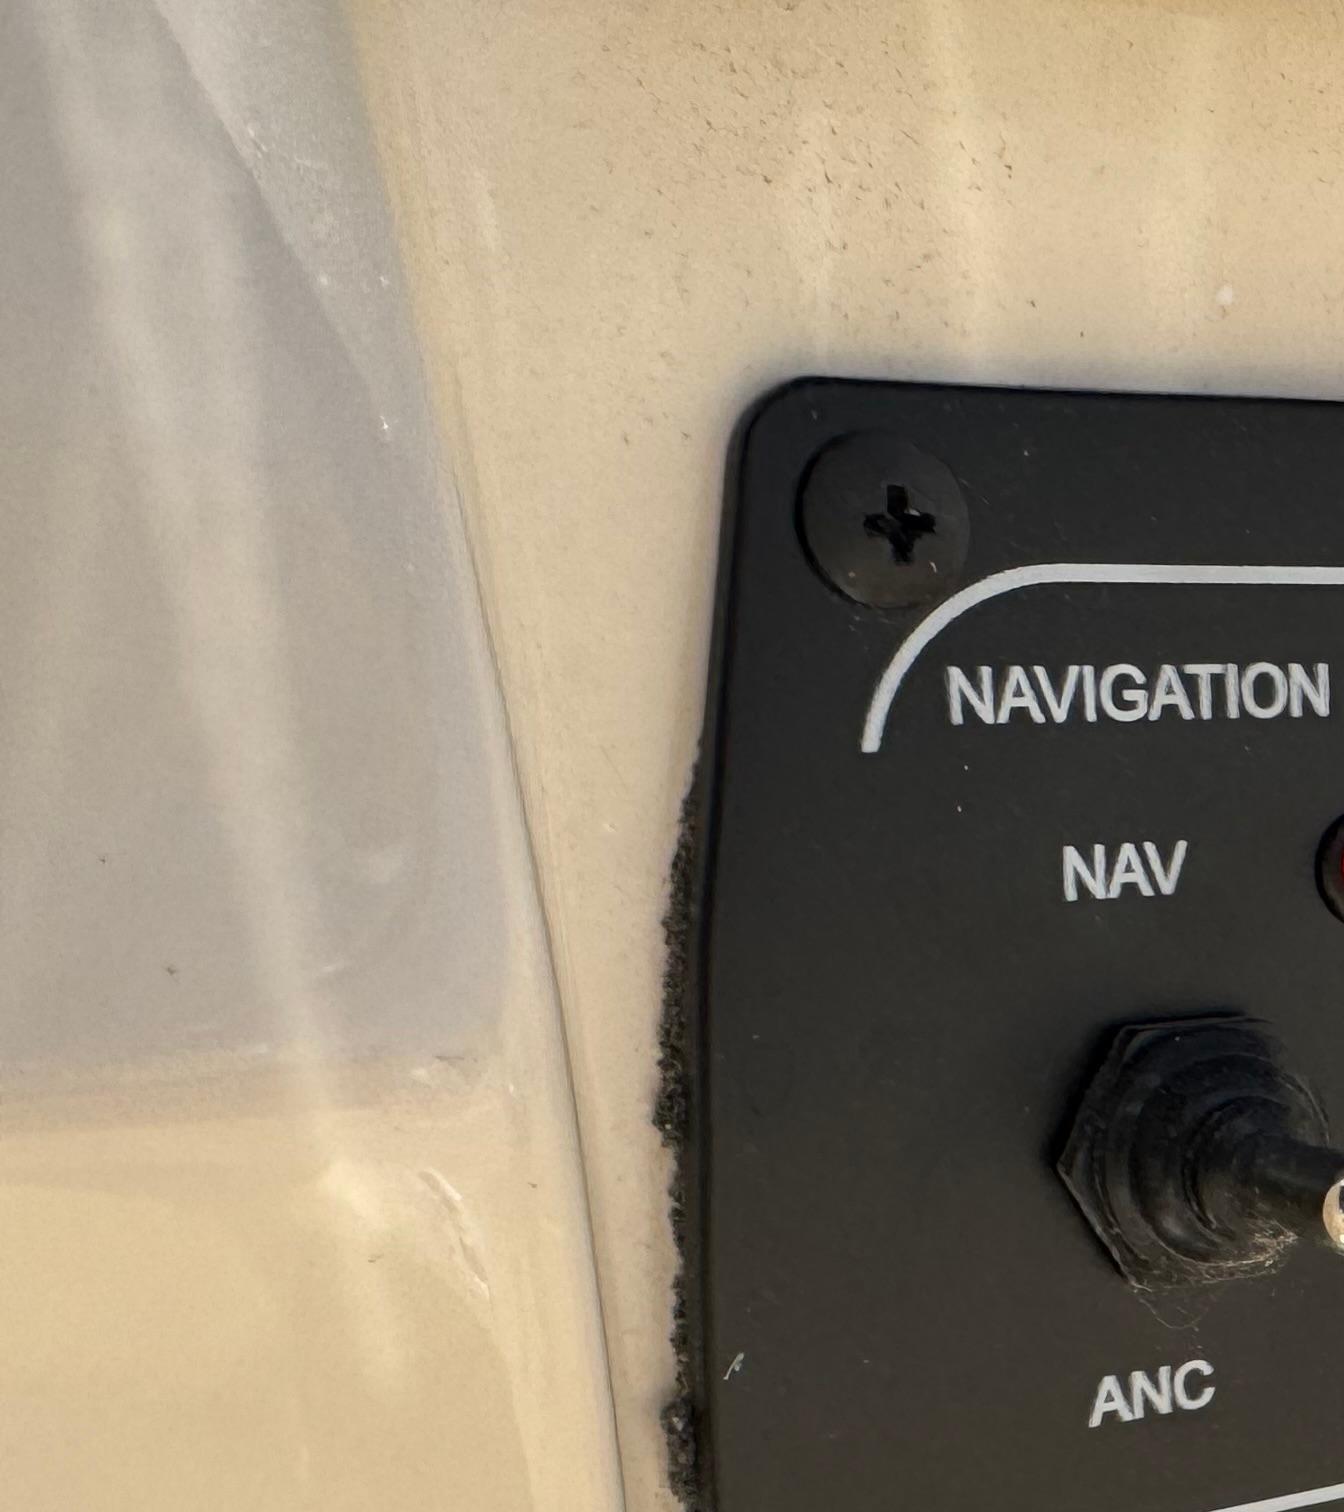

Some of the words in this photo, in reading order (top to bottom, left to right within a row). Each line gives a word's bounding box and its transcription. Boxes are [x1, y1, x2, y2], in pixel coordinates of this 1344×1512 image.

[947, 661, 1330, 725] NAVIGATION
[1062, 839, 1188, 902] NAV
[1088, 1359, 1216, 1428] ANC
